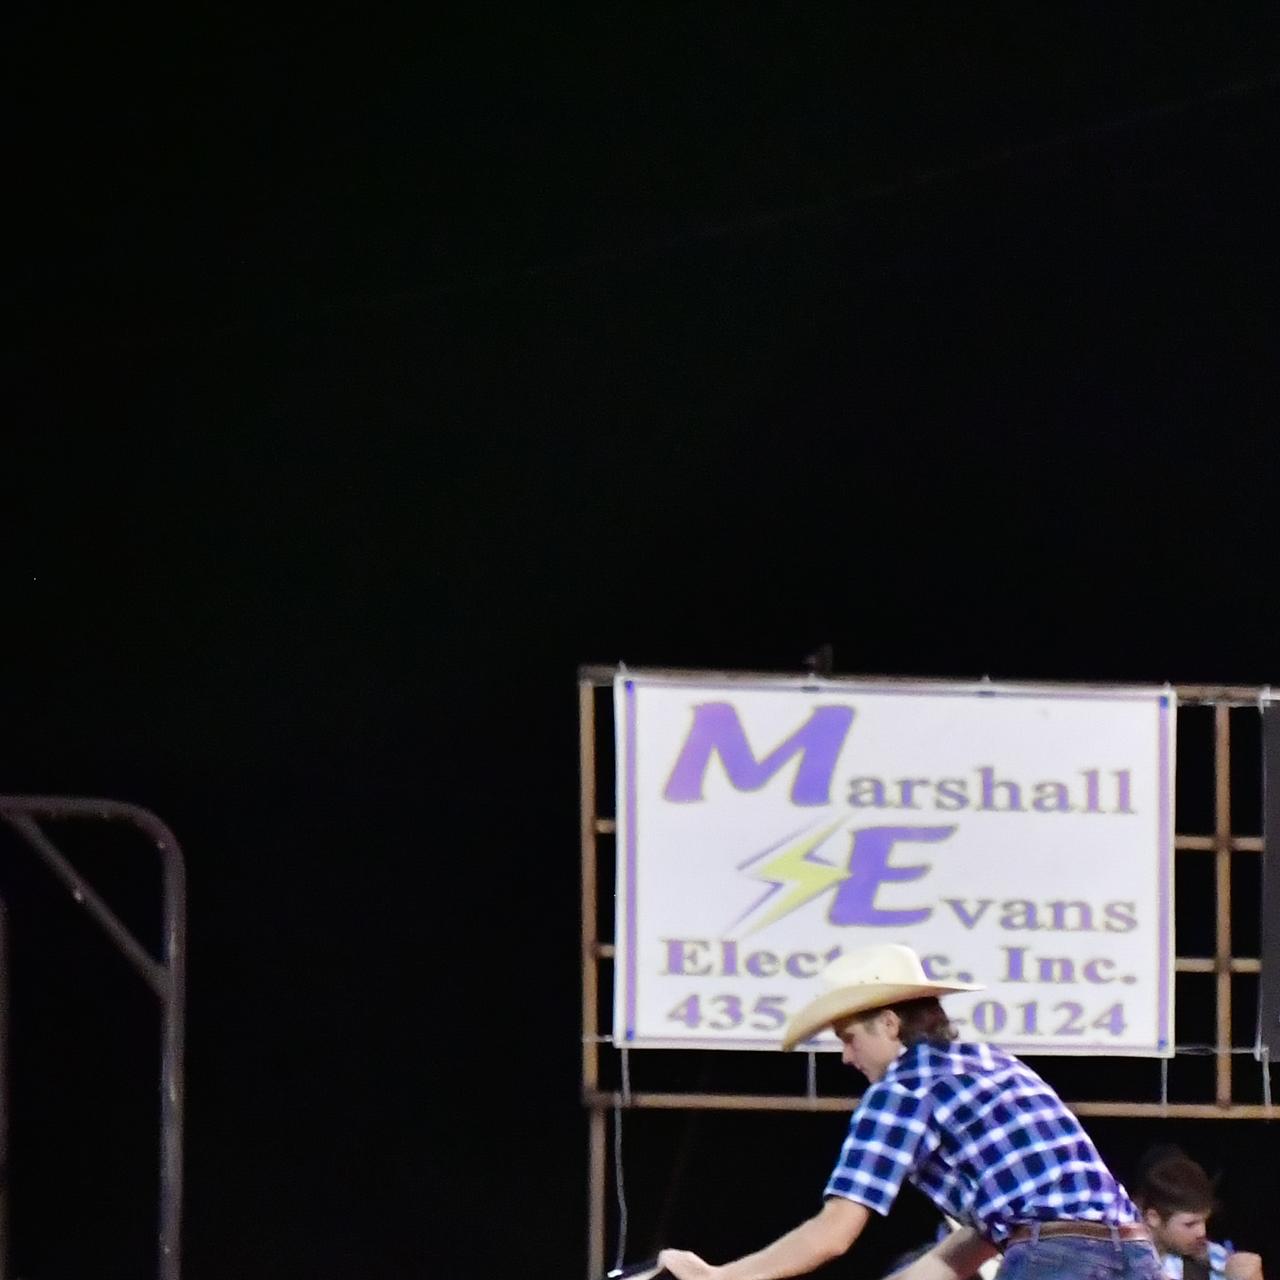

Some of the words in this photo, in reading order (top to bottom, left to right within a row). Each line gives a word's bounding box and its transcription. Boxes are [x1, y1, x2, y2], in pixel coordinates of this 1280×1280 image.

[662, 701, 1137, 815] Marshall
[828, 825, 1138, 934] Evans
[998, 945, 1138, 986] Inc.
[667, 992, 1129, 1038] 435-0124
